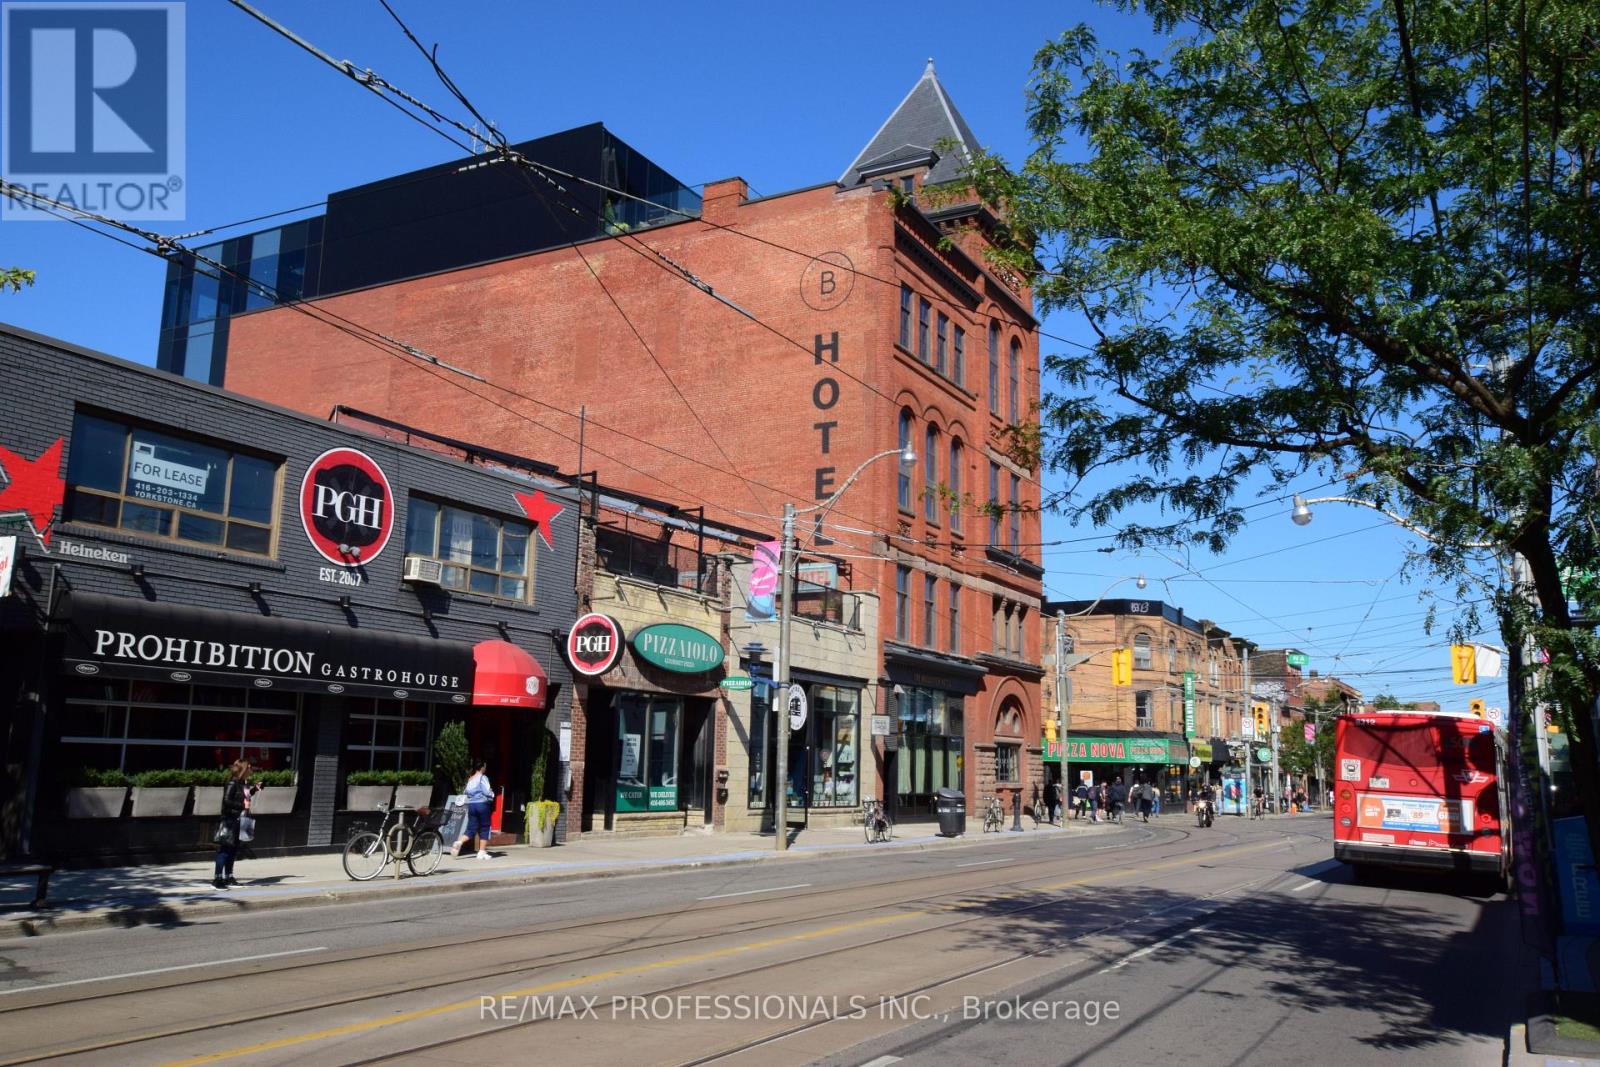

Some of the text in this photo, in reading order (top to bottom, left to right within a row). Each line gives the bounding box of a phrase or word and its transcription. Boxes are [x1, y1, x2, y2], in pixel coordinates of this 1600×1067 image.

[812, 331, 840, 546] HOTEL
[134, 461, 203, 487] FOR LEASE
[134, 490, 197, 508] YORKSTONE.CA
[135, 482, 198, 501] 416-203-1334
[311, 483, 384, 530] PGH
[59, 541, 130, 564] Heineken
[319, 567, 361, 587] EST. 2007
[574, 635, 612, 653] PGH
[643, 632, 718, 663] PIZZAIOLO
[93, 629, 459, 688] PROHIBITION GASTROHOUSE
[1048, 742, 1086, 758] PIZA
[1091, 743, 1125, 758] NOVA
